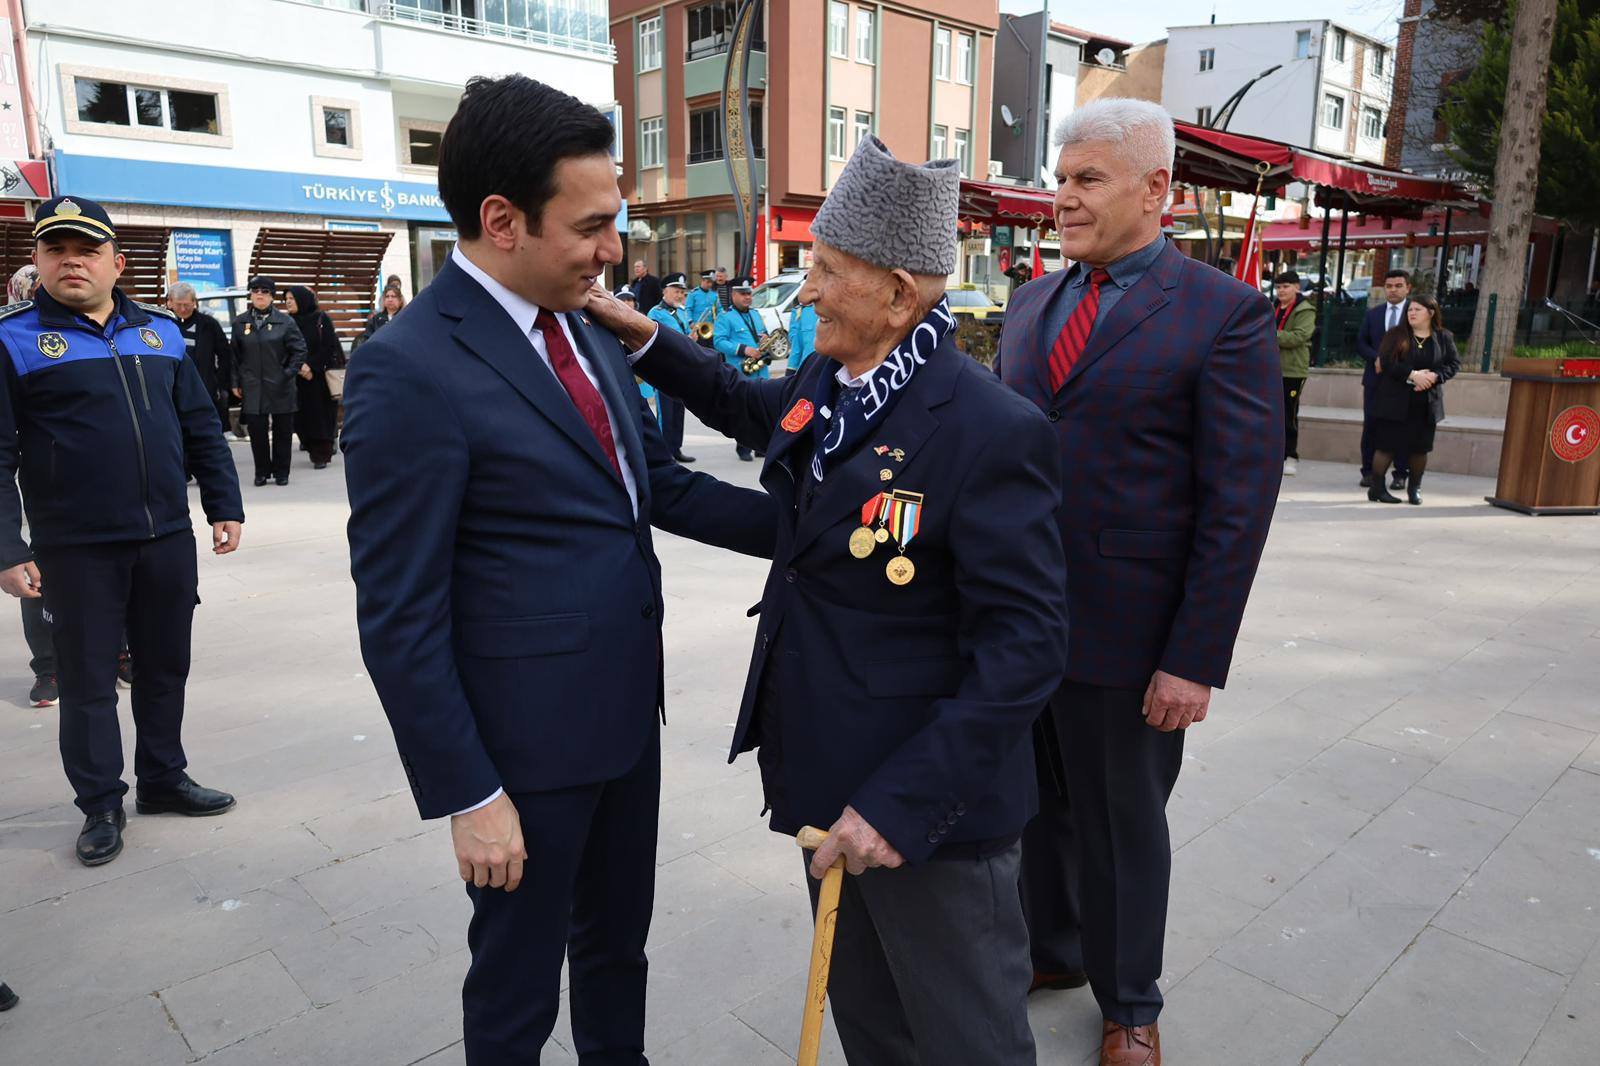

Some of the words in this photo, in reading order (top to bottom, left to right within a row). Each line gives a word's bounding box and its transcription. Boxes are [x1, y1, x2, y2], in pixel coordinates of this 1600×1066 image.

[302, 183, 378, 203] TÜRKİYE
[397, 192, 445, 208] BANK
[856, 297, 957, 421] KORE
